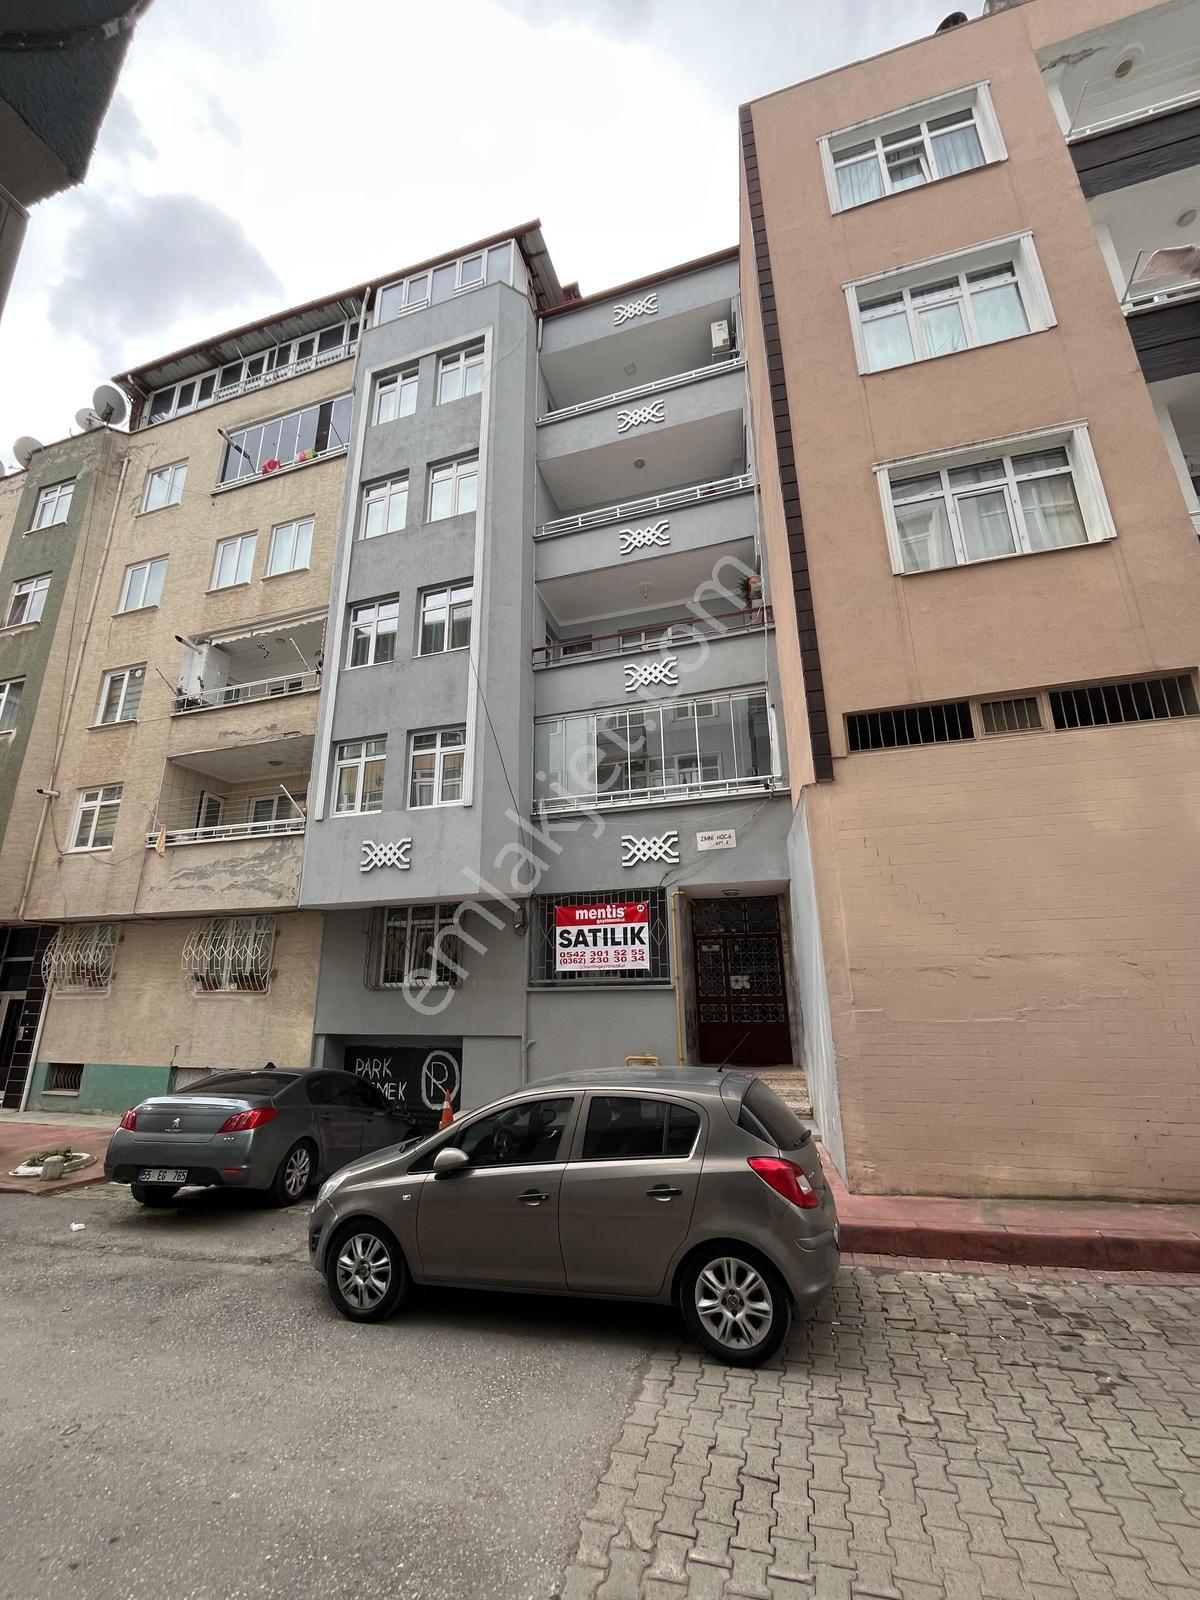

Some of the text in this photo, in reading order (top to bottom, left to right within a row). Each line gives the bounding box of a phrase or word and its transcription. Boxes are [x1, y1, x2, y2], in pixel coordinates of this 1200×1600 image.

[575, 905, 625, 919] mentis
[558, 926, 646, 948] SATILIK
[631, 948, 645, 956] 55
[559, 957, 586, 965] (0362)
[589, 956, 609, 964] 230
[355, 1056, 392, 1080] PARK
[366, 1081, 408, 1101] MEK
[157, 1170, 167, 1180] EG
[173, 1170, 187, 1181] 765
